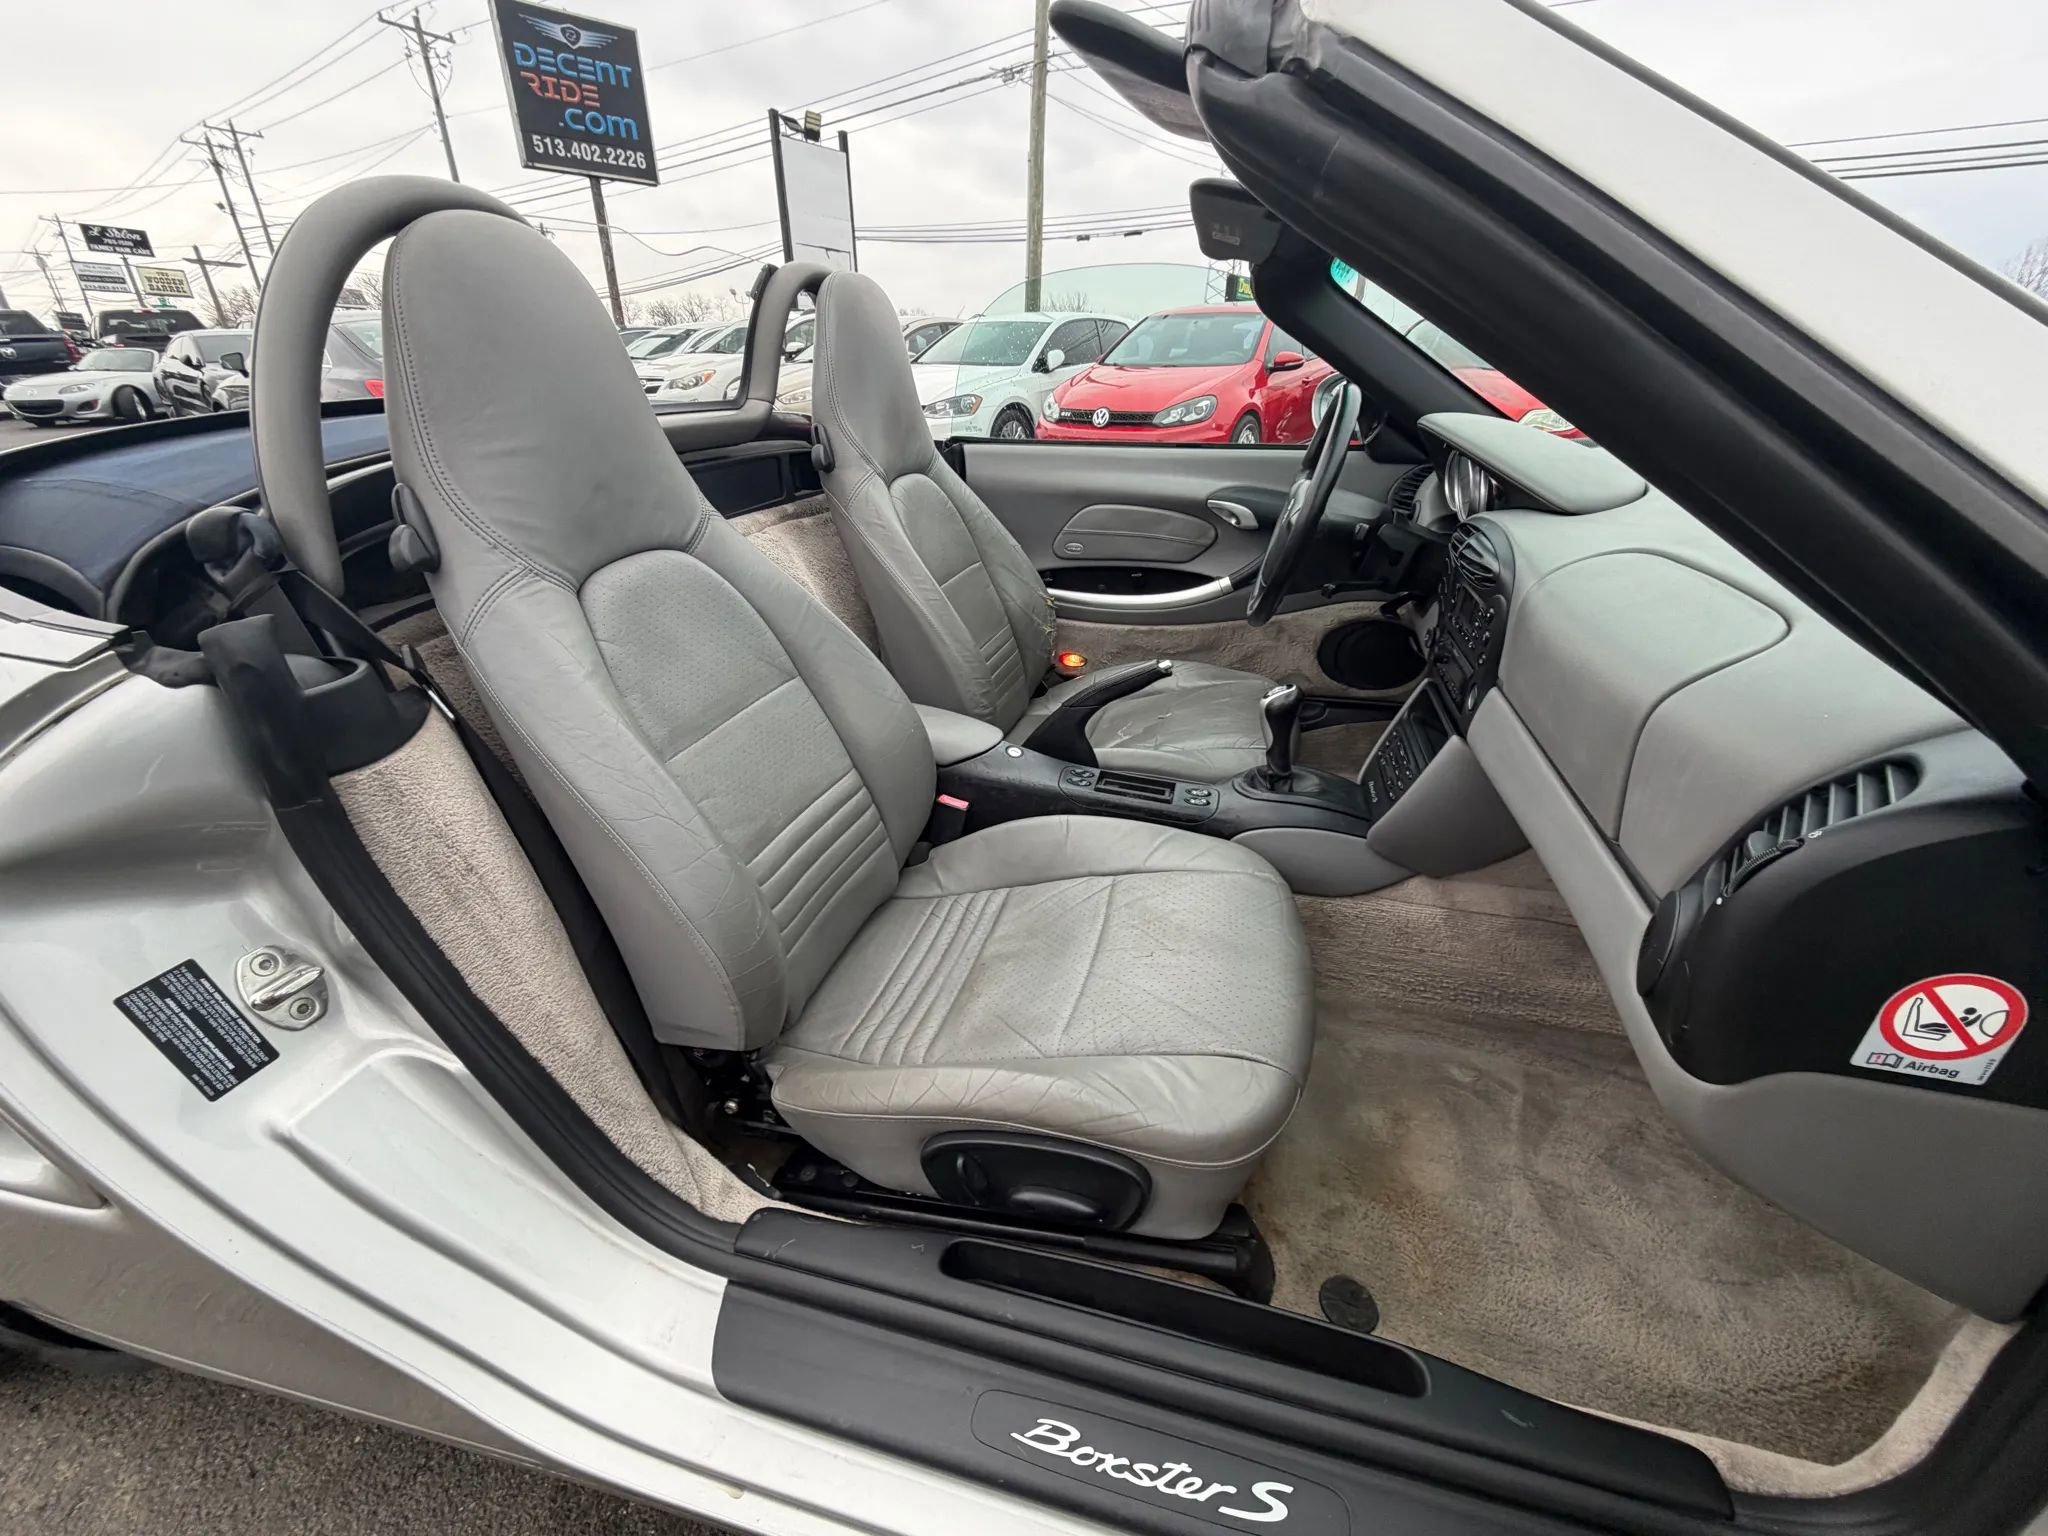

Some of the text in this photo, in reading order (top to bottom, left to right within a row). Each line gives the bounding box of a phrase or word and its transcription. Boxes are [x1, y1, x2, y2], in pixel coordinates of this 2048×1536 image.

[513, 41, 632, 88] DECENT
[520, 71, 600, 107] RIDE
[531, 134, 647, 169] 513.402.2226
[90, 244, 151, 256] FAMILY HAIR CARE
[145, 275, 184, 286] WOODEN
[148, 284, 187, 294] BARREL
[1903, 1060, 1960, 1079] Airbag
[1010, 1418, 1294, 1522] Boxster S
